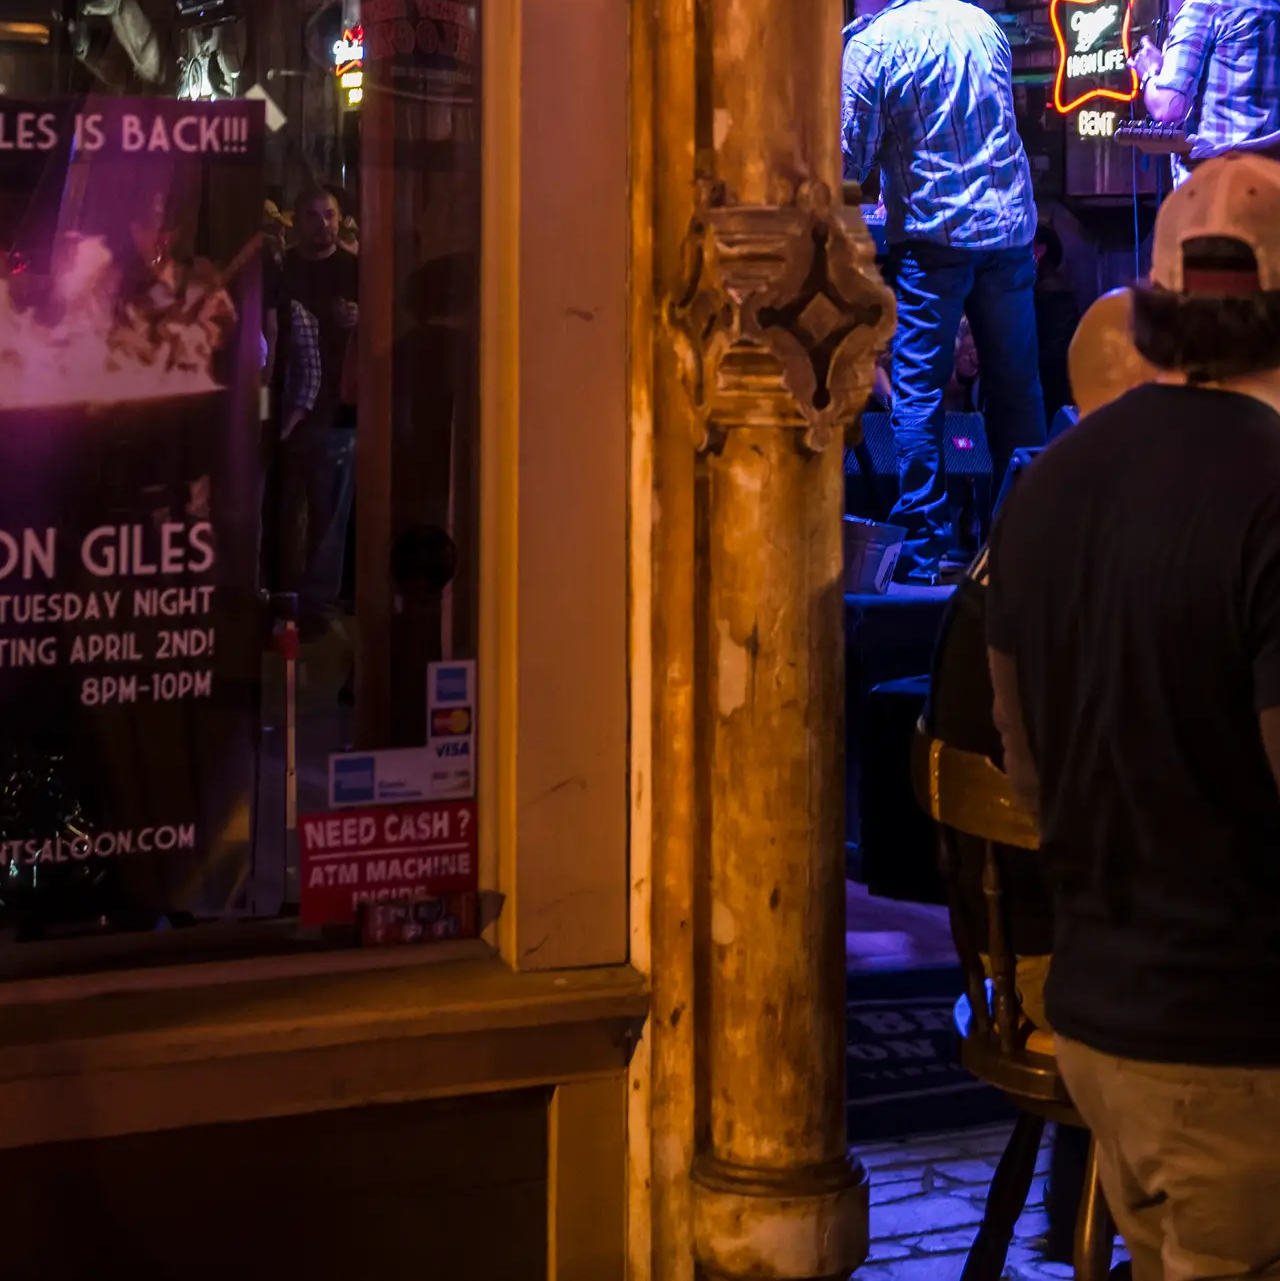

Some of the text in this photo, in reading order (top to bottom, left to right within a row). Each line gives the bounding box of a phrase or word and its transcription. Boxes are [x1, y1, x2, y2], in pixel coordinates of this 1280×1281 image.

[75, 114, 104, 151] IS
[122, 115, 248, 154] BACK!!!
[81, 521, 215, 578] GILES
[133, 585, 215, 618] NIGHT
[69, 632, 142, 663] APRIL
[154, 628, 215, 660] 2ND!
[81, 671, 213, 707] 8PM-10PM
[435, 741, 470, 758] VISA
[304, 817, 376, 850] NEED
[384, 811, 449, 842] CASH
[309, 853, 470, 889] ATM MACHINE
